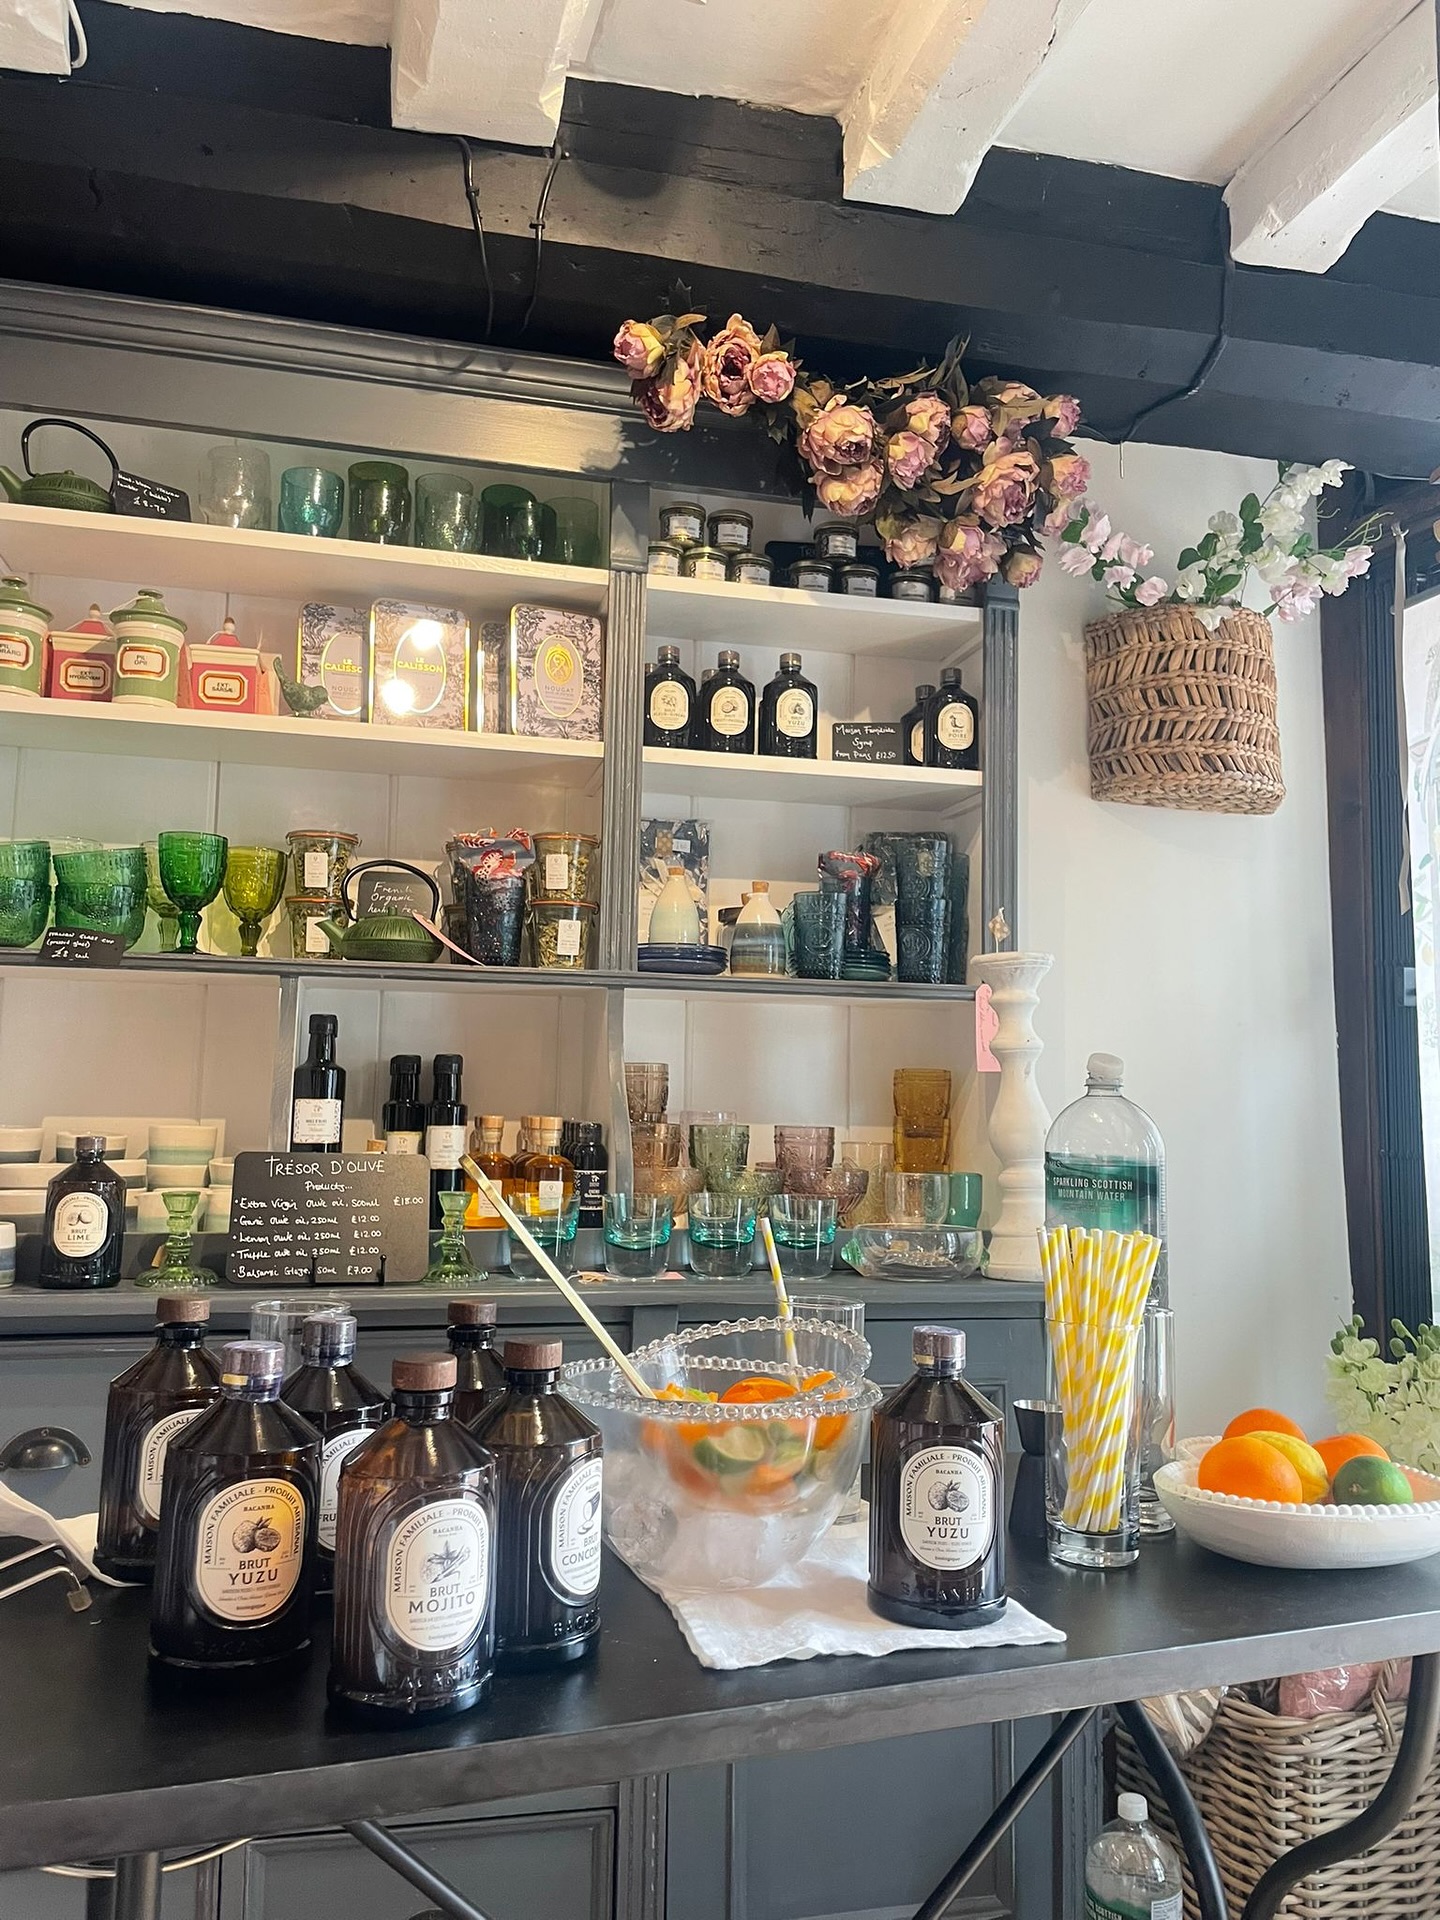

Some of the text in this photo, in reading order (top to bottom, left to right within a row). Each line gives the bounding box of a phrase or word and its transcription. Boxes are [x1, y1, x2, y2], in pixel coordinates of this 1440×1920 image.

[397, 660, 443, 673] CALISSON
[544, 685, 575, 693] NOUGAT
[835, 724, 861, 735] Maison
[852, 737, 873, 749] Syrup
[371, 893, 413, 906] Organic
[51, 946, 69, 958] £8
[264, 1155, 385, 1178] TRÉSOR D'OLIVE
[1052, 1176, 1133, 1191] SPARKLING SCOTTISH
[1057, 1188, 1125, 1202] MOUNTAIN WATER
[239, 1197, 268, 1209] Extra
[271, 1197, 298, 1211] Virgin
[305, 1198, 328, 1208] olive
[351, 1198, 380, 1208] 500ml
[269, 1214, 290, 1225] olive
[310, 1216, 339, 1225] 250ml
[351, 1215, 380, 1224] £12.00
[239, 1231, 271, 1246] Lemon
[314, 1232, 341, 1241] 250ml
[353, 1229, 382, 1239] £12.00
[236, 1248, 271, 1260] Truffle
[311, 1247, 341, 1256] 250ml
[349, 1245, 380, 1256] £12.00
[237, 1264, 280, 1278] Balsamic
[316, 1266, 337, 1275] 50ml
[347, 1265, 373, 1276] £7.00
[321, 1438, 356, 1468] AMILIALE
[147, 1447, 156, 1481] MAISON
[909, 1453, 945, 1479] FAMILIALE
[952, 1453, 981, 1474] PRODUIT
[558, 1469, 592, 1548] MAISON FAMILIALE
[204, 1523, 215, 1565] MAISON
[211, 1486, 255, 1521] FAMILIALE
[264, 1485, 297, 1505] PRODUIT
[934, 1516, 962, 1526] BRUT
[583, 1531, 599, 1547] BRUT
[927, 1526, 969, 1538] YUZU
[393, 1549, 403, 1593] MAISON
[400, 1509, 443, 1547] FAMILIALE
[452, 1507, 482, 1528] PRODUIT
[239, 1557, 271, 1570] BRUT
[229, 1568, 278, 1586] YUZU
[429, 1583, 460, 1598] BRUT
[408, 1591, 475, 1614] MOJITO
